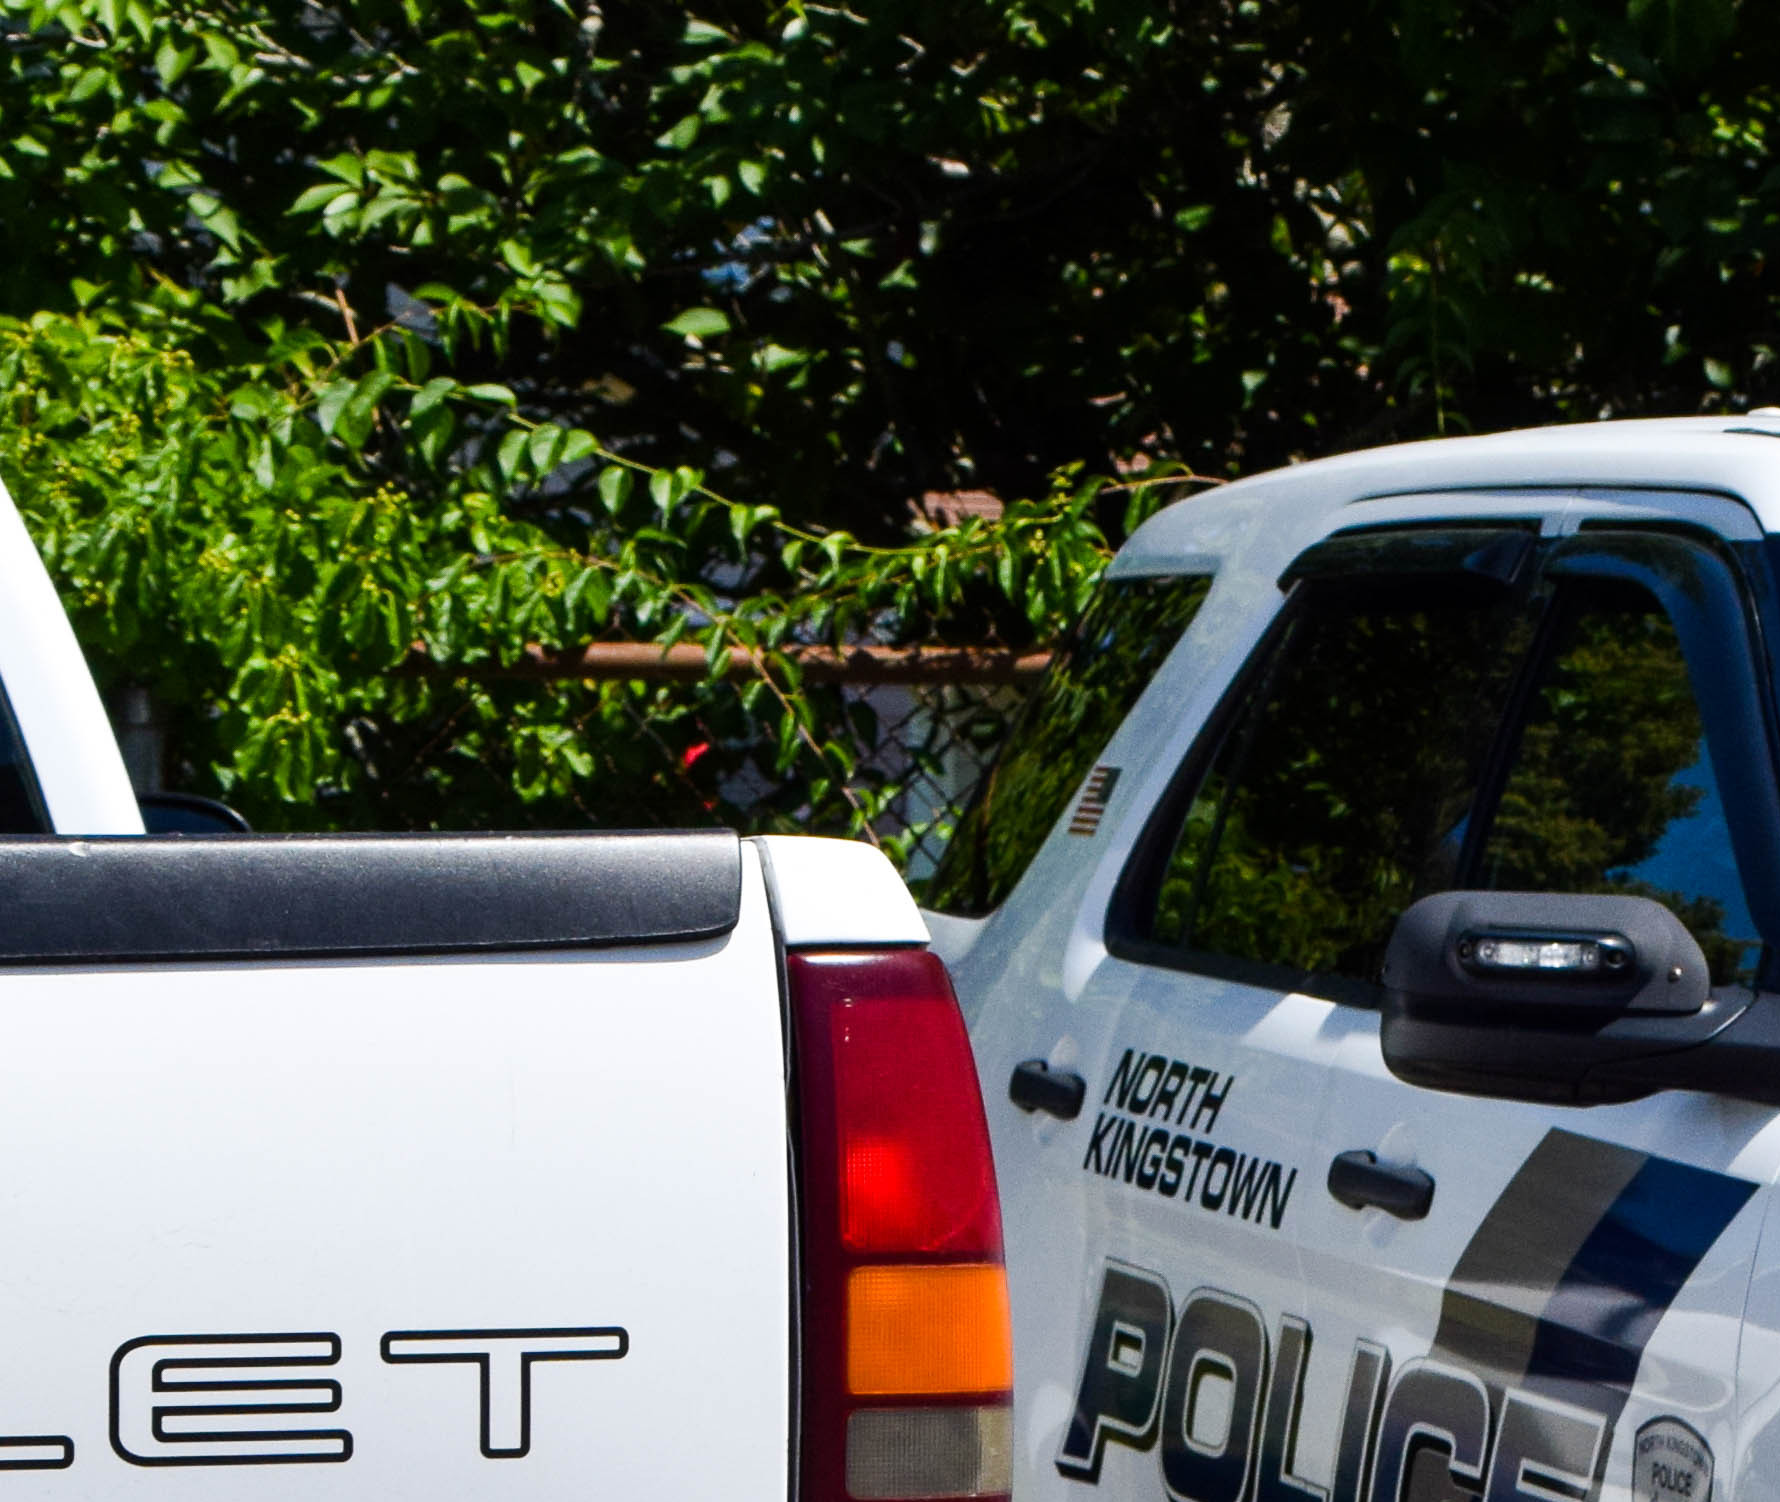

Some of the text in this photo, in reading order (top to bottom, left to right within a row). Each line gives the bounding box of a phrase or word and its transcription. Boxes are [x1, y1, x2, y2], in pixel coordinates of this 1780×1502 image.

[1103, 1048, 1235, 1134] NORTH
[1083, 1111, 1298, 1230] KINGSTOWN
[1652, 1461, 1693, 1497] POLICE
